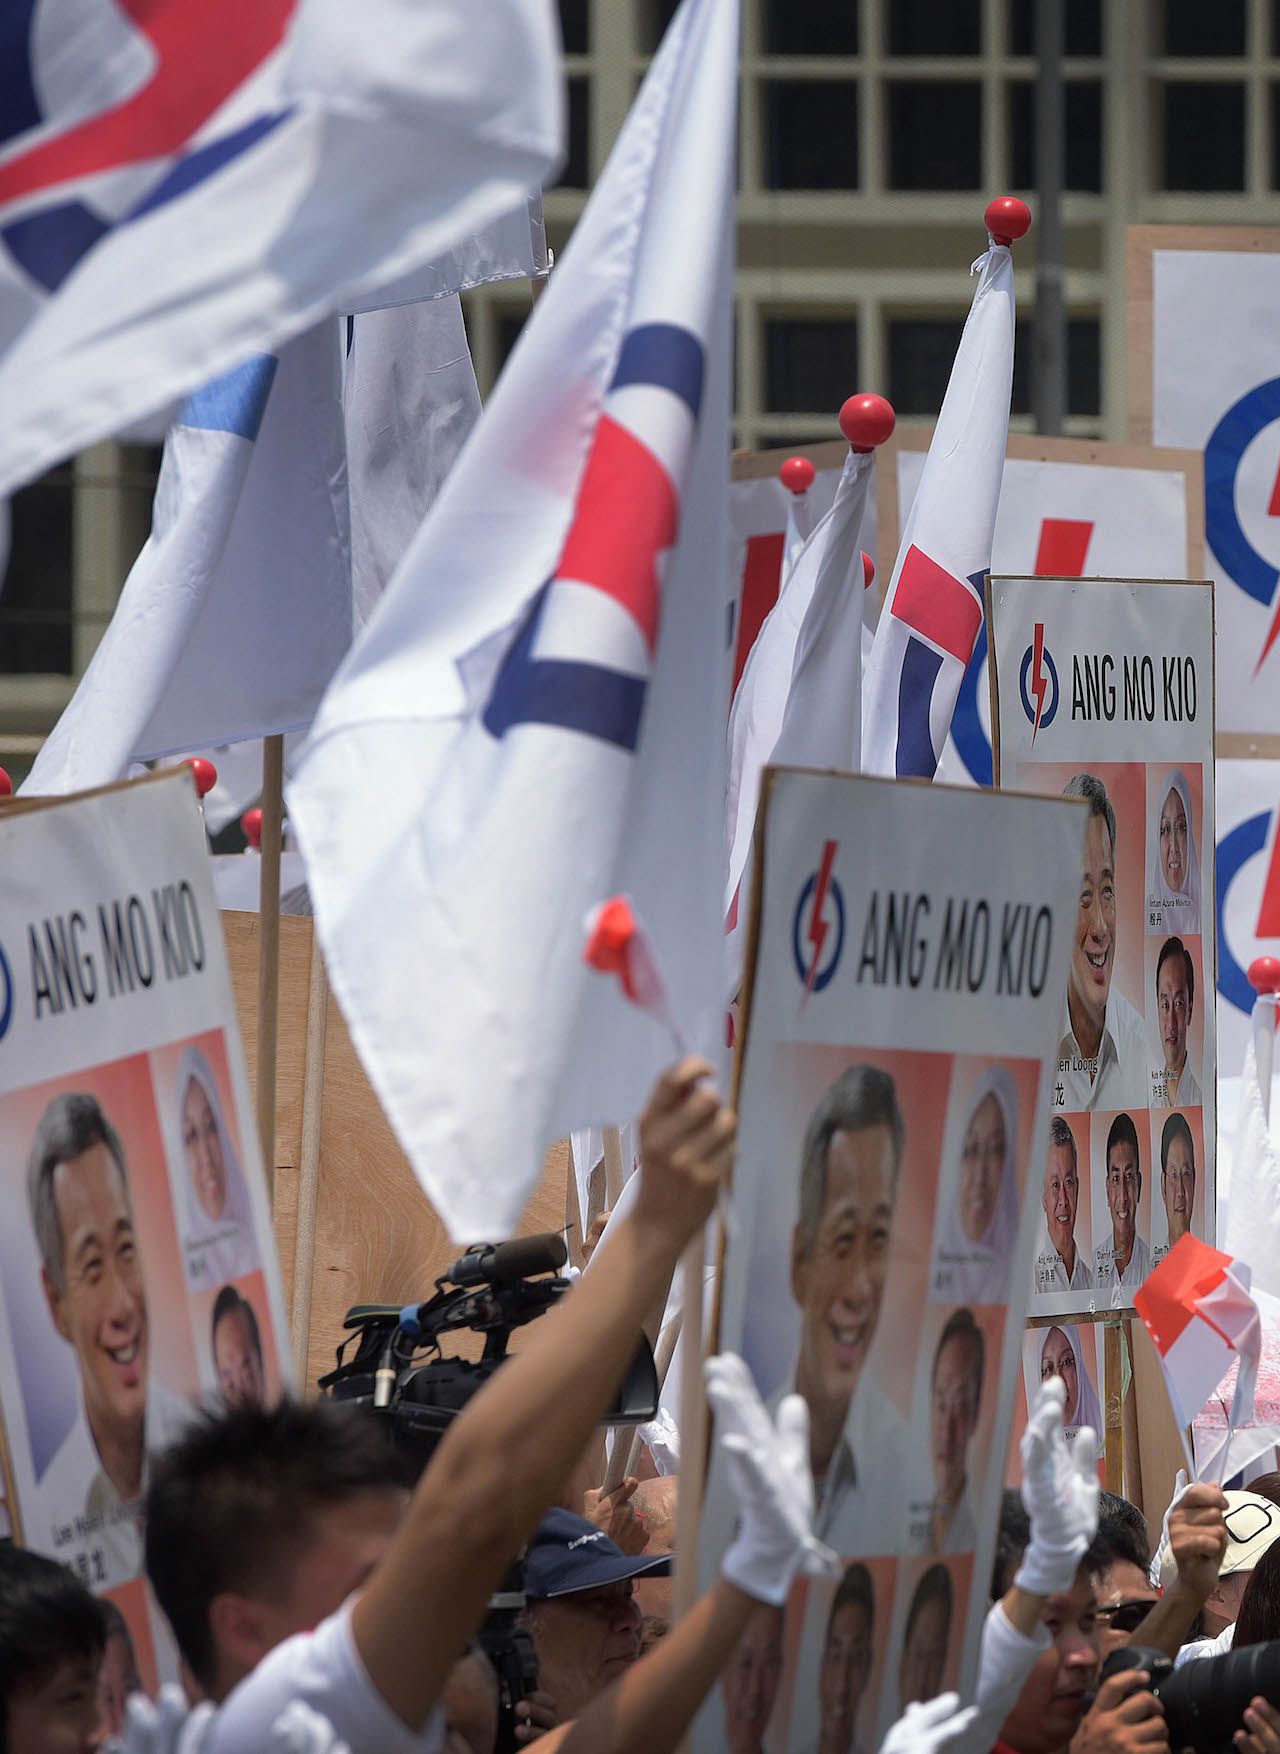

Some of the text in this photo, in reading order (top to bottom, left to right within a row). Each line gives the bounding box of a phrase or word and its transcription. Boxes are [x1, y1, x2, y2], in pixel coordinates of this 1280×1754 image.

[1071, 654, 1196, 722] ANG MO KIO
[27, 879, 205, 1020] ANG MO KIO
[857, 890, 1052, 998] ANG MO KIO
[1072, 1057, 1098, 1074] Loong
